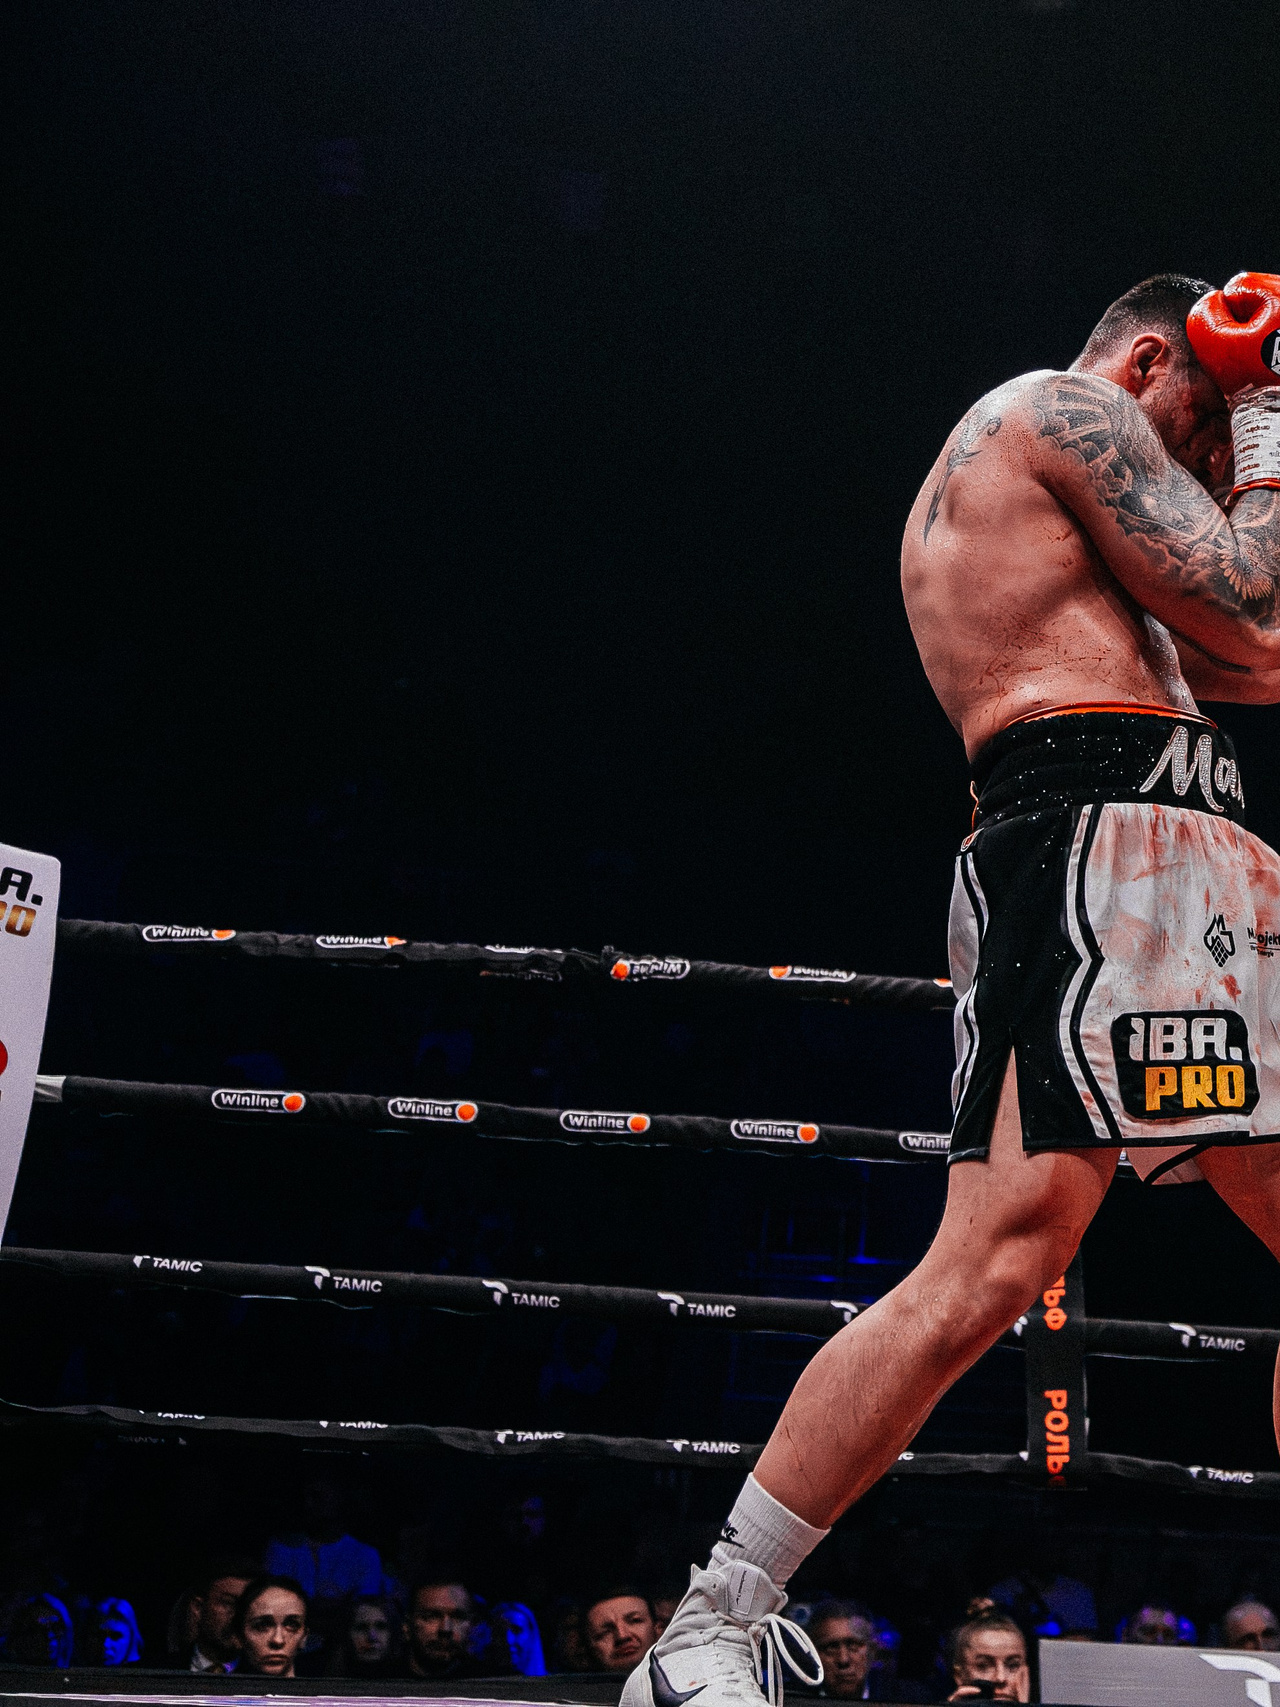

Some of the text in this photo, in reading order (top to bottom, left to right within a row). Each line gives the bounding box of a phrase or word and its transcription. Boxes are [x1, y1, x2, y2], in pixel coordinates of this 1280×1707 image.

[1138, 725, 1245, 812] Ma
[1145, 1064, 1245, 1111] PRO
[220, 1093, 279, 1109] Winline
[395, 1101, 453, 1118] Winline
[568, 1114, 626, 1130] Winline
[738, 1122, 796, 1138] Winline
[152, 1256, 203, 1273] TAMIC
[332, 1276, 383, 1293] TAMIC
[511, 1292, 561, 1309] TAMIC
[687, 1302, 737, 1319] TAMIC
[1199, 1335, 1246, 1352] TAMIC
[1043, 1388, 1070, 1484] РОЛЬ
[691, 1440, 741, 1454] TAMIC
[1206, 1467, 1254, 1484] TAMIC
